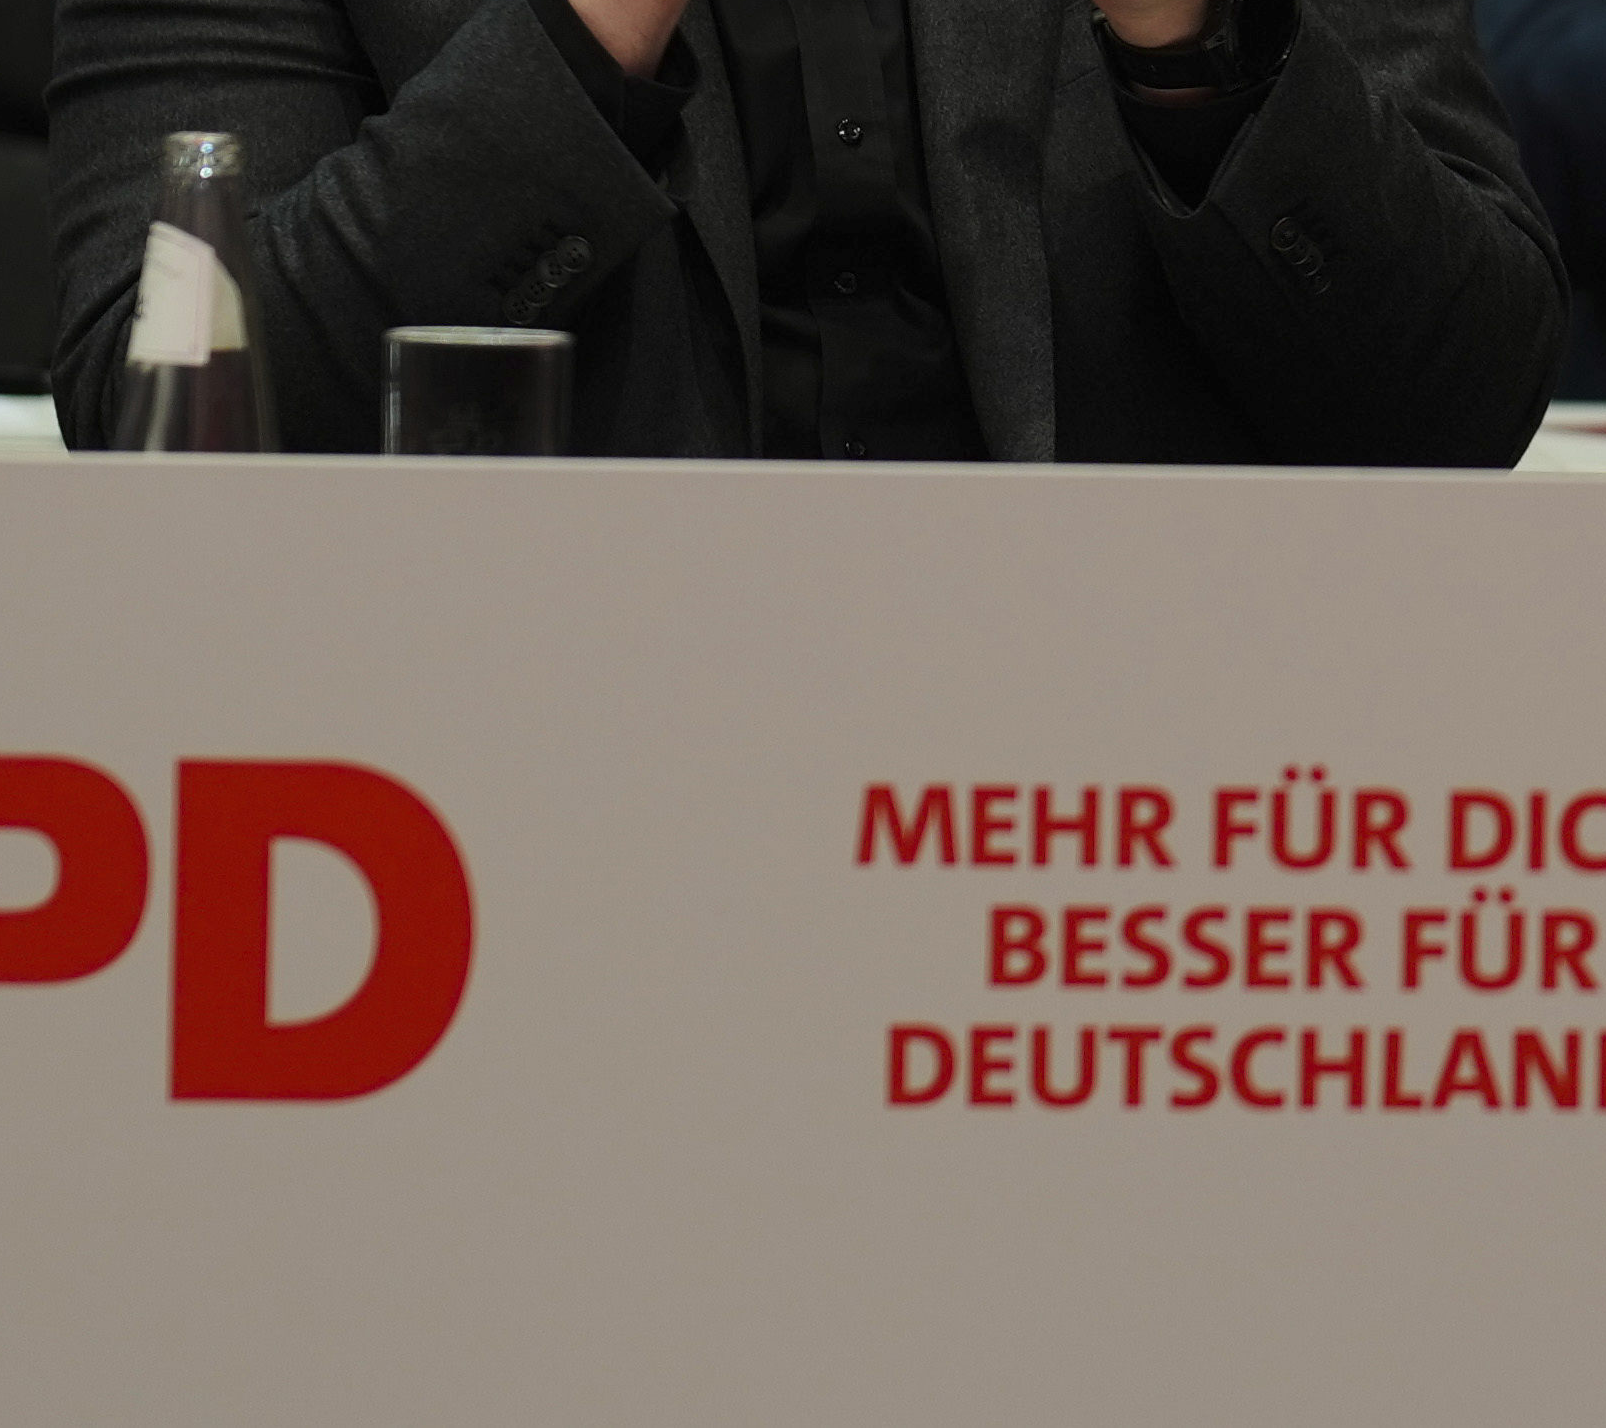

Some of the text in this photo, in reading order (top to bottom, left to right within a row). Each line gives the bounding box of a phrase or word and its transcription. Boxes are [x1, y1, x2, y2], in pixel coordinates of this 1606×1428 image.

[857, 783, 1174, 868] MEHR
[1213, 767, 1410, 871] FÜR
[989, 888, 1597, 992] BESSER FÜR
